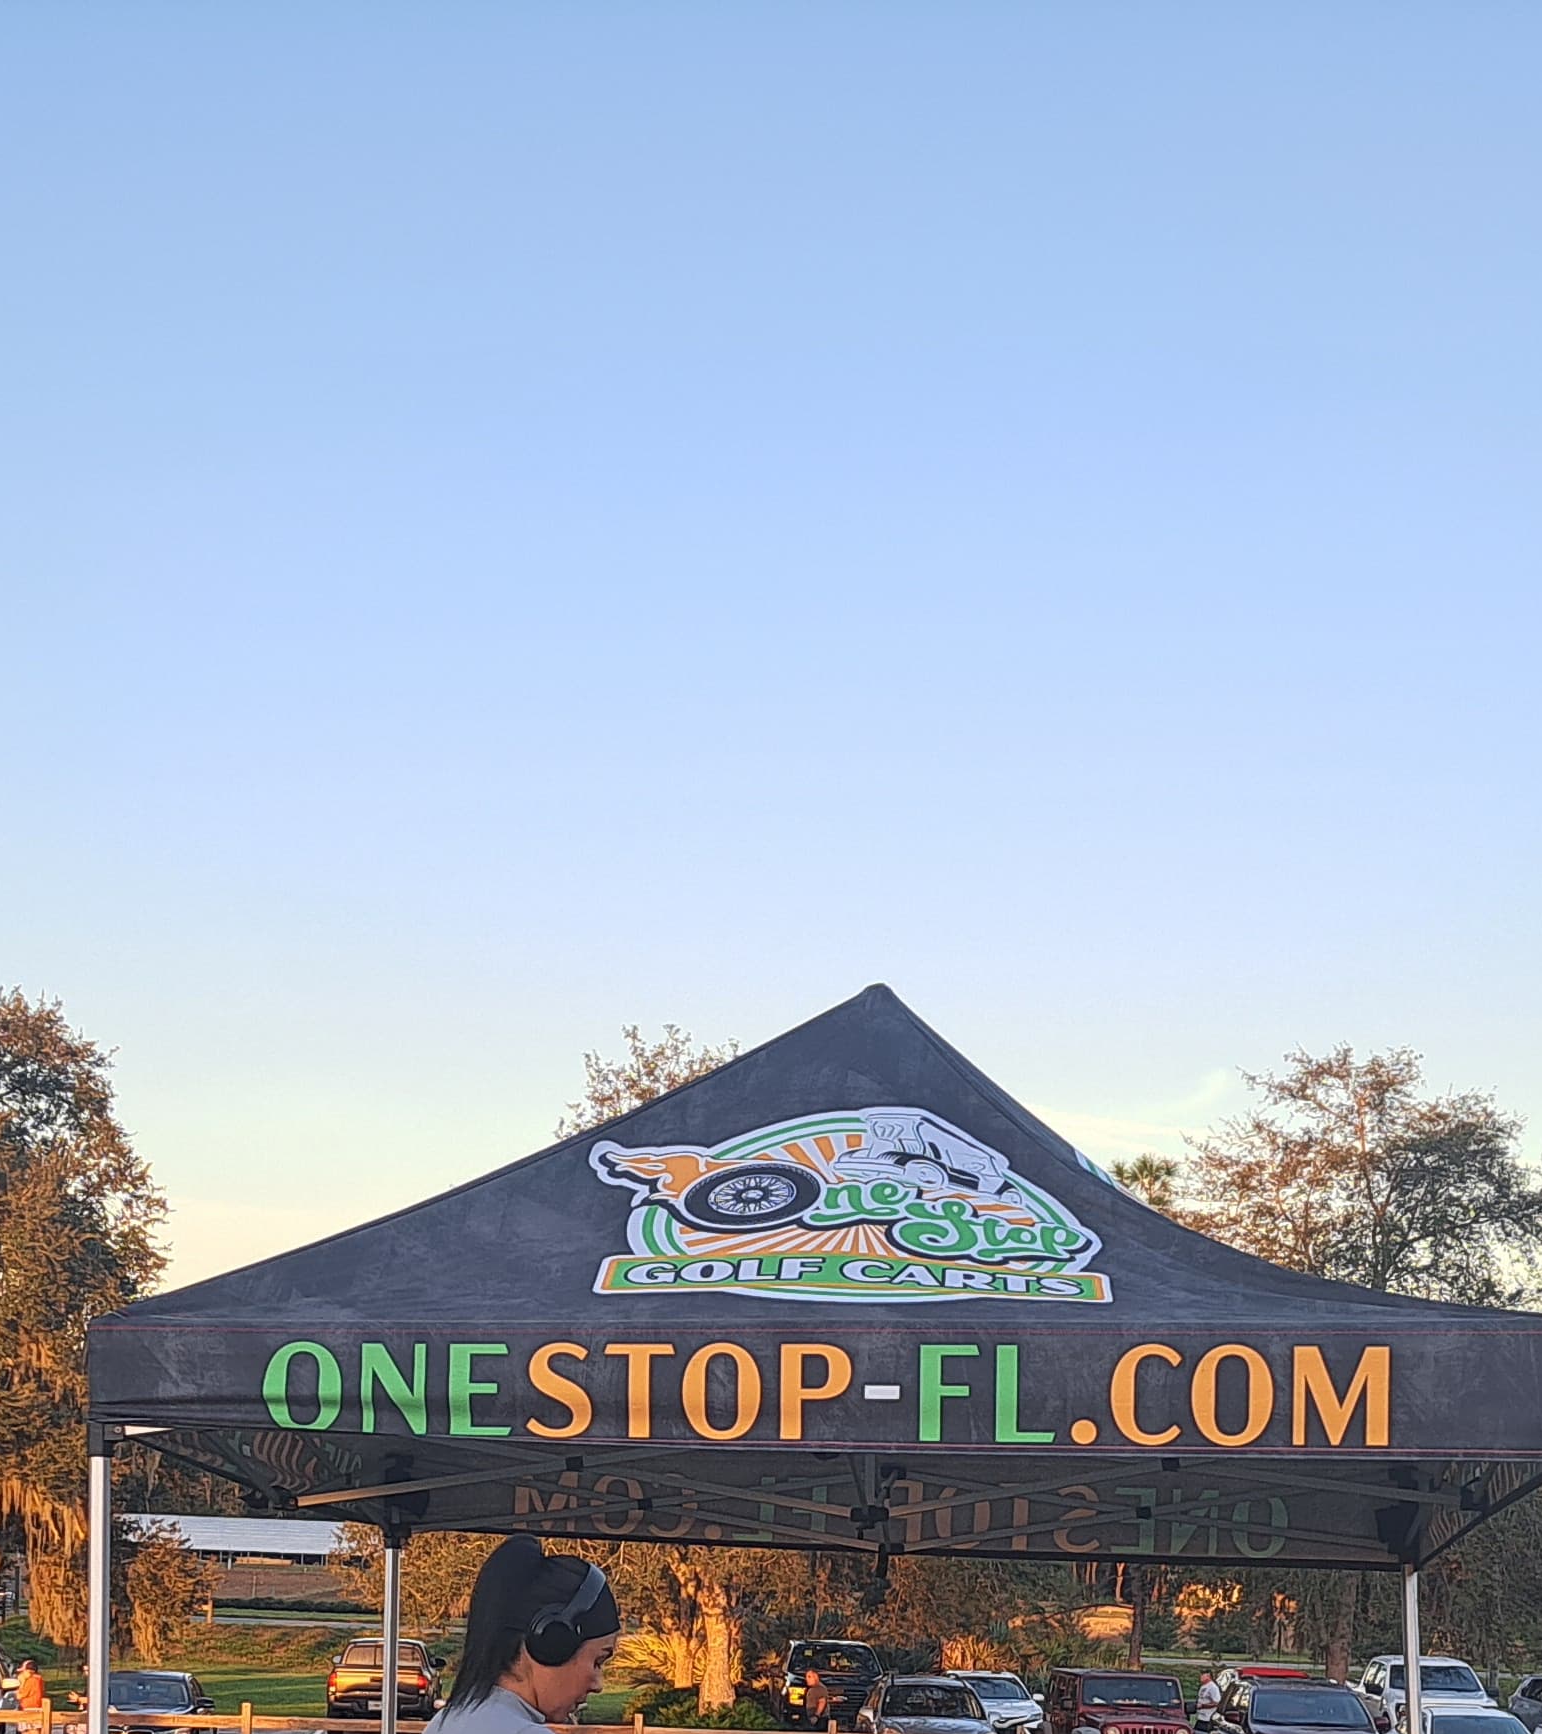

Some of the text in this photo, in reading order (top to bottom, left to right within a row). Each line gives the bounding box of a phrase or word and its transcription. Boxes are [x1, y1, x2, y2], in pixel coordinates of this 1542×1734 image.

[898, 1200, 1087, 1259] Stop
[627, 1257, 1086, 1298] GOLF CARTS
[262, 1340, 1391, 1447] ONESTOP-FL.COM
